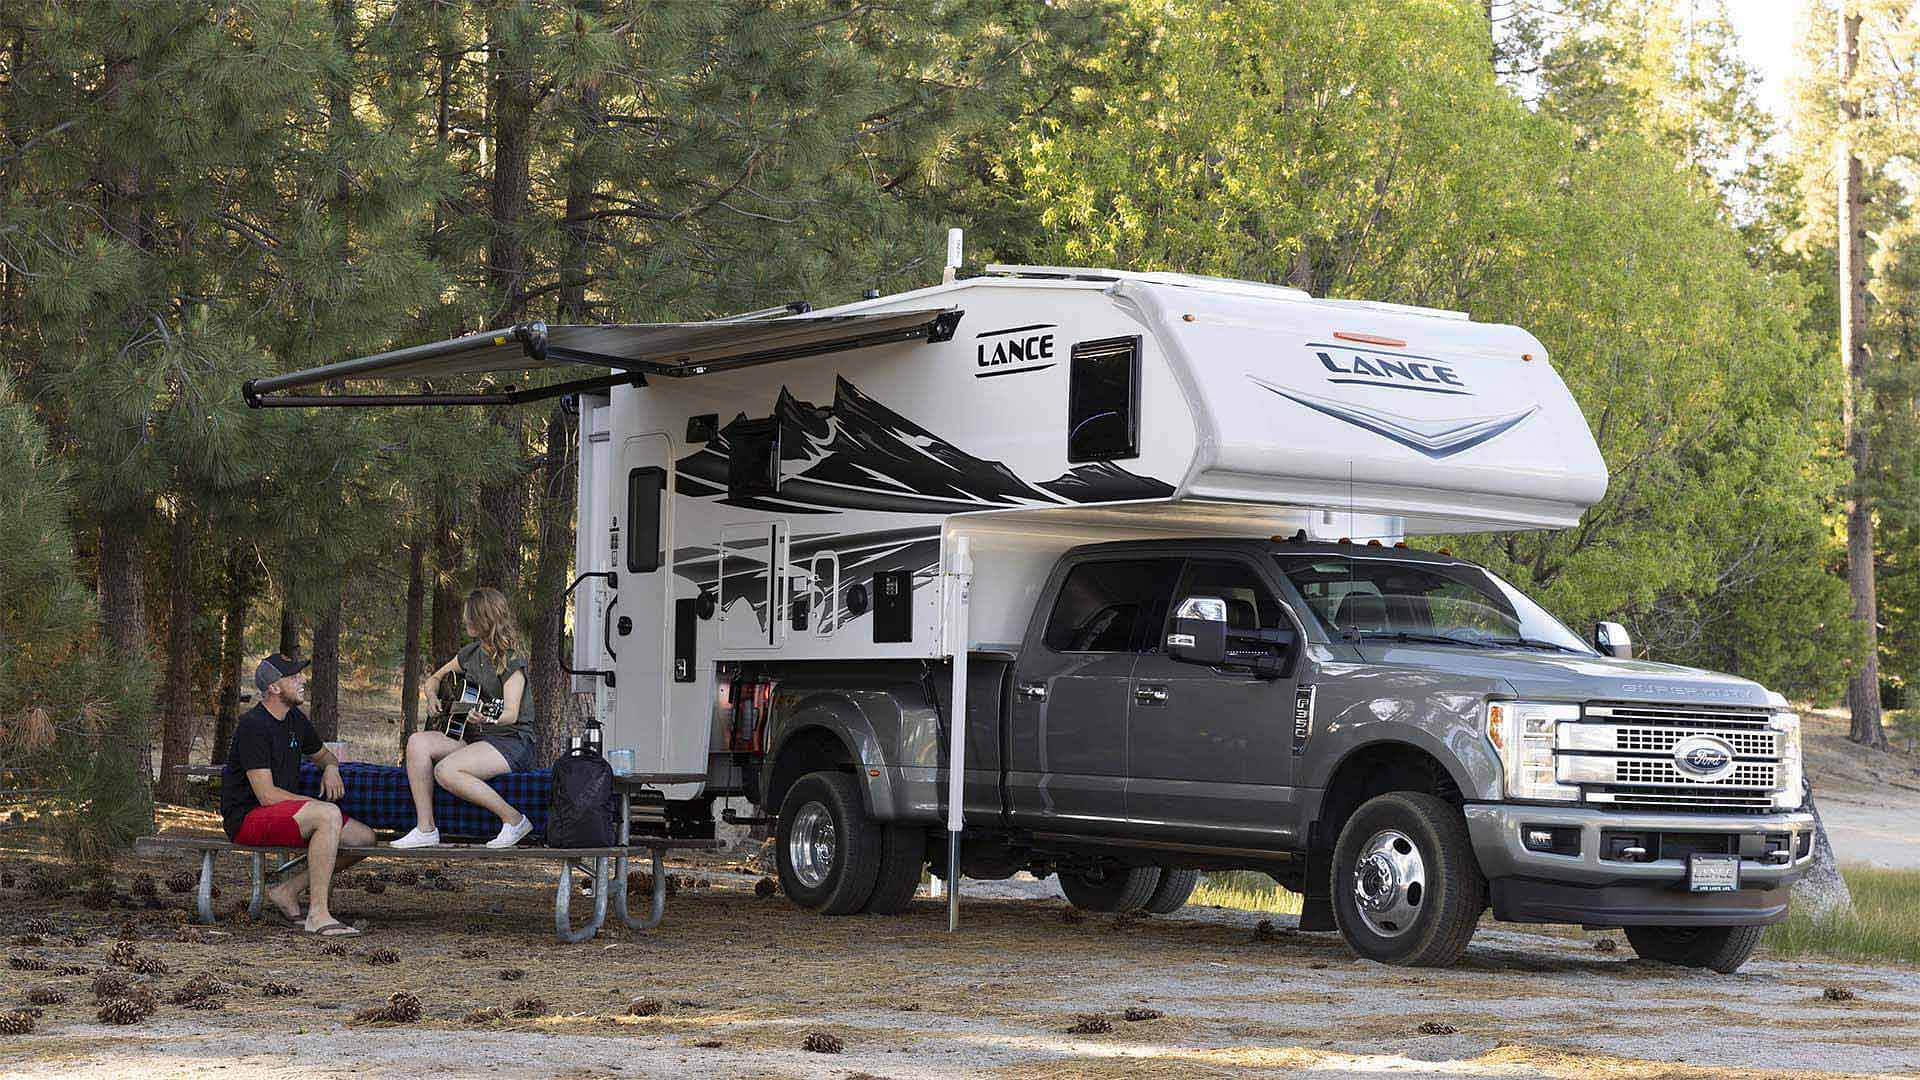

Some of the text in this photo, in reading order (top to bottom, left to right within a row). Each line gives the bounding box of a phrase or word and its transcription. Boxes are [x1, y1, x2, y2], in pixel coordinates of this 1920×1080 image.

[977, 334, 1054, 367] LANCE
[1316, 352, 1465, 387] LANCE
[1694, 749, 1722, 767] Ford
